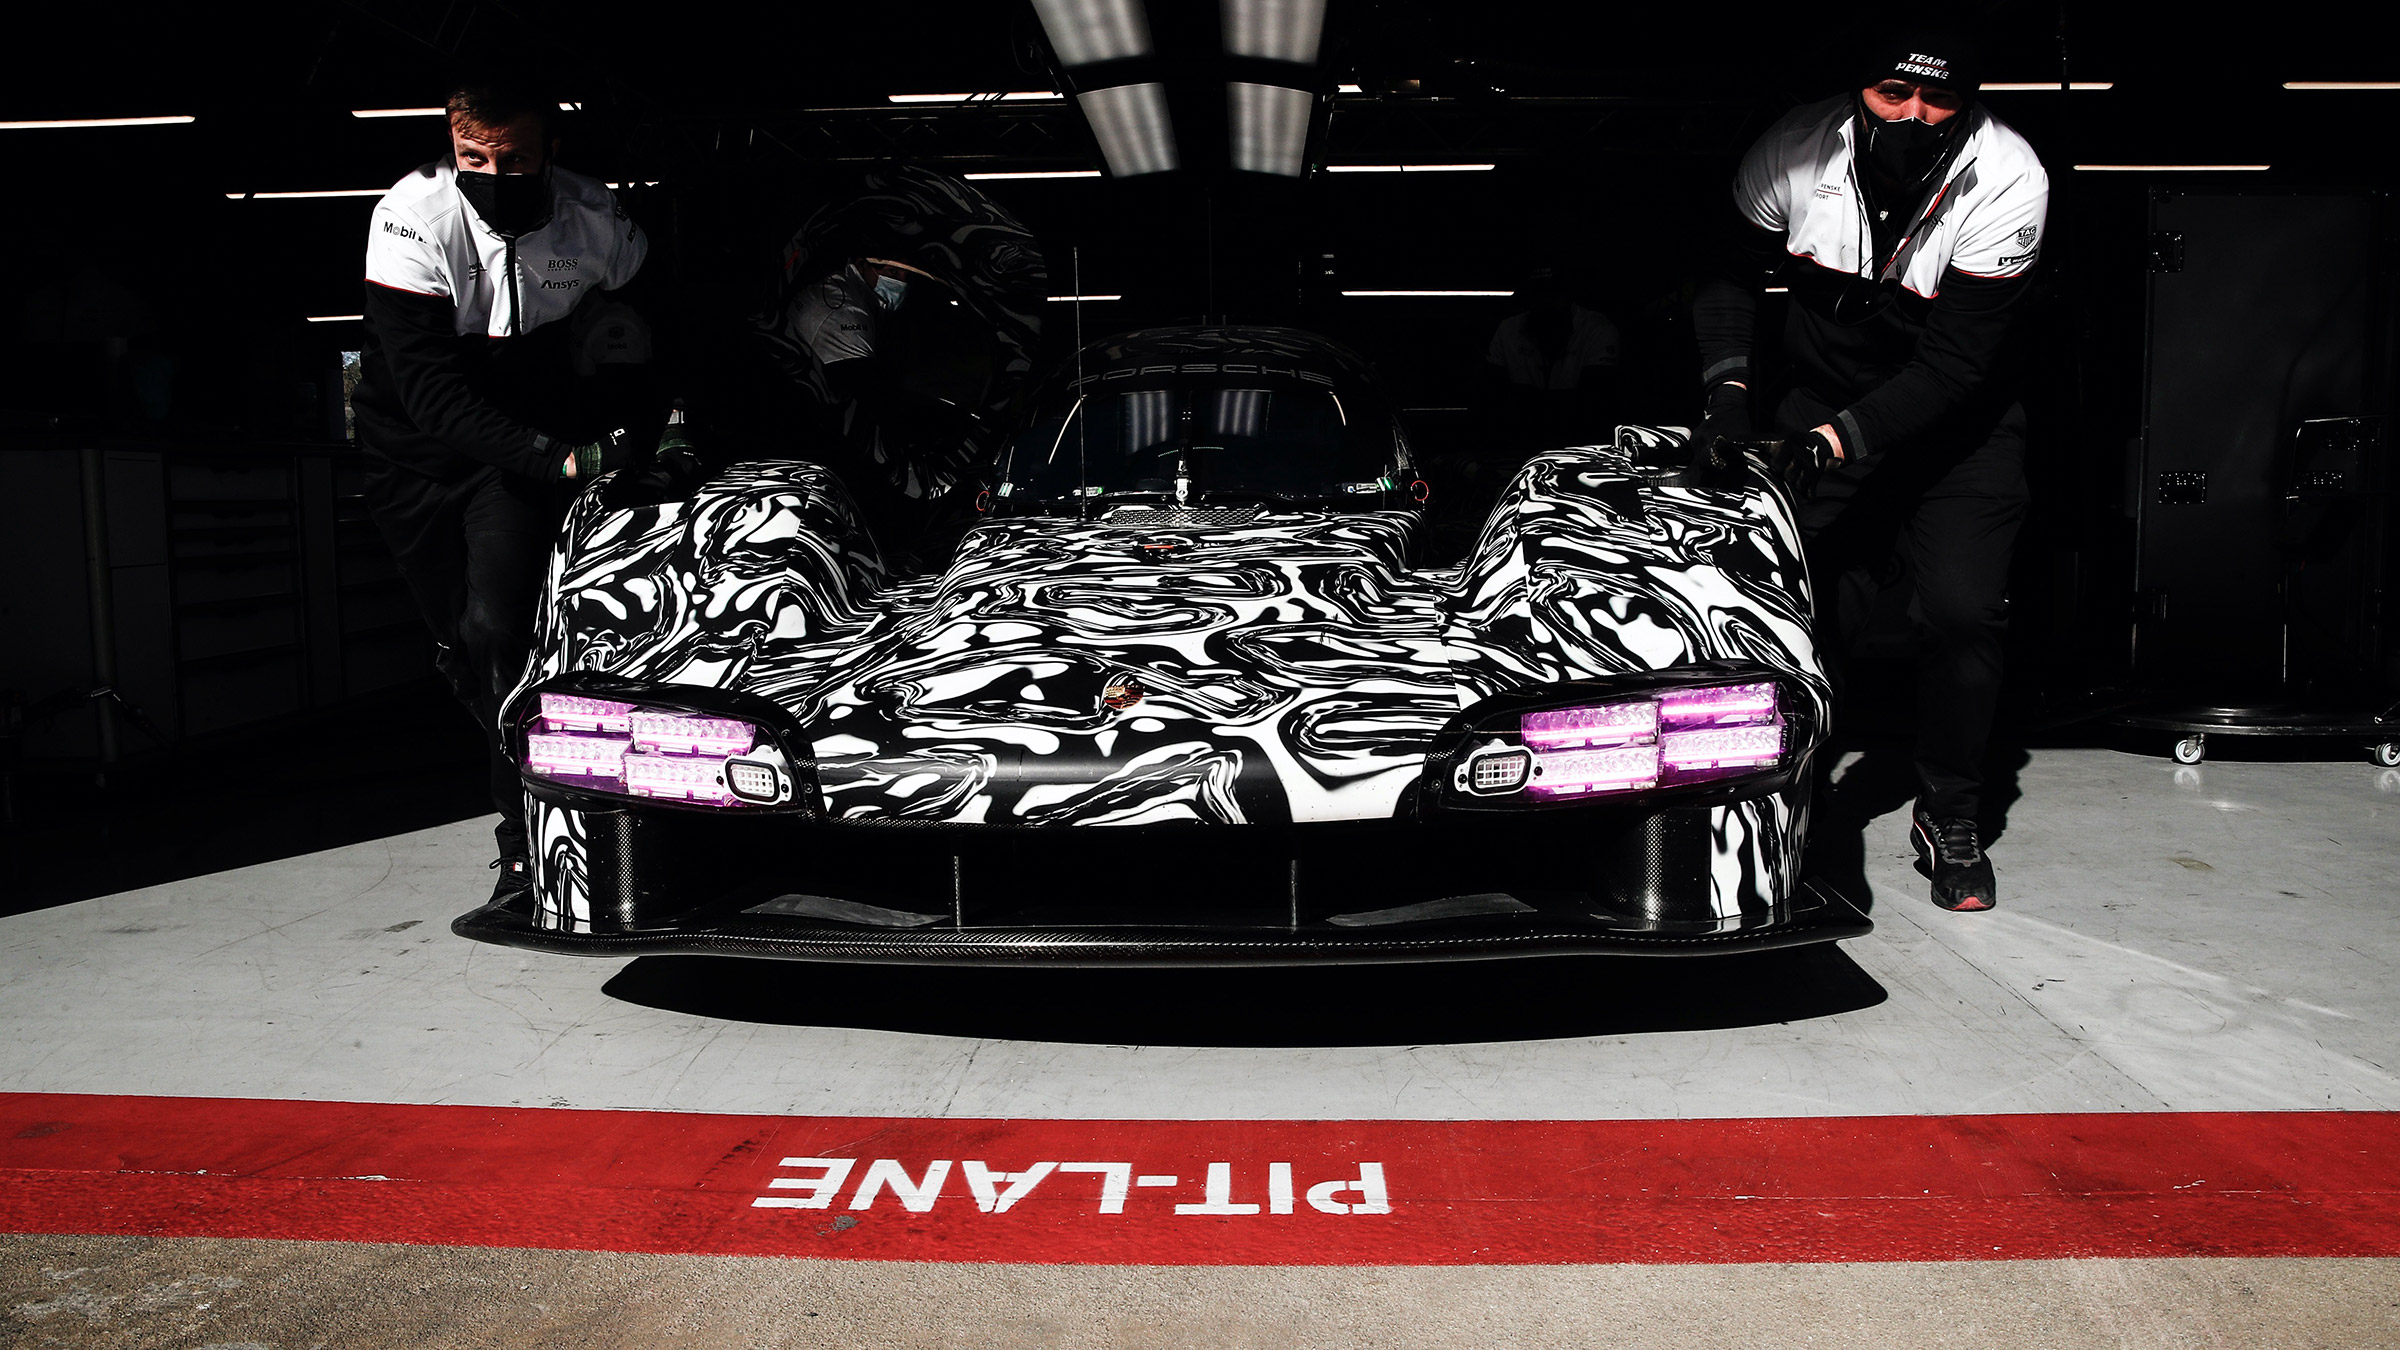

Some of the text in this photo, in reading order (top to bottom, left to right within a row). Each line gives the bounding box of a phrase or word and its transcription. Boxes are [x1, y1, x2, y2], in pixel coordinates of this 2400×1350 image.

[1908, 53, 1947, 67] TEAM
[1895, 62, 1950, 79] PENSKE
[383, 221, 416, 240] Mobil
[2018, 226, 2037, 237] TAG
[548, 259, 578, 269] BOSS
[541, 279, 580, 290] Ansys
[1066, 363, 1335, 392] PORSCHE
[751, 1156, 1393, 1215] PIT-LANE
